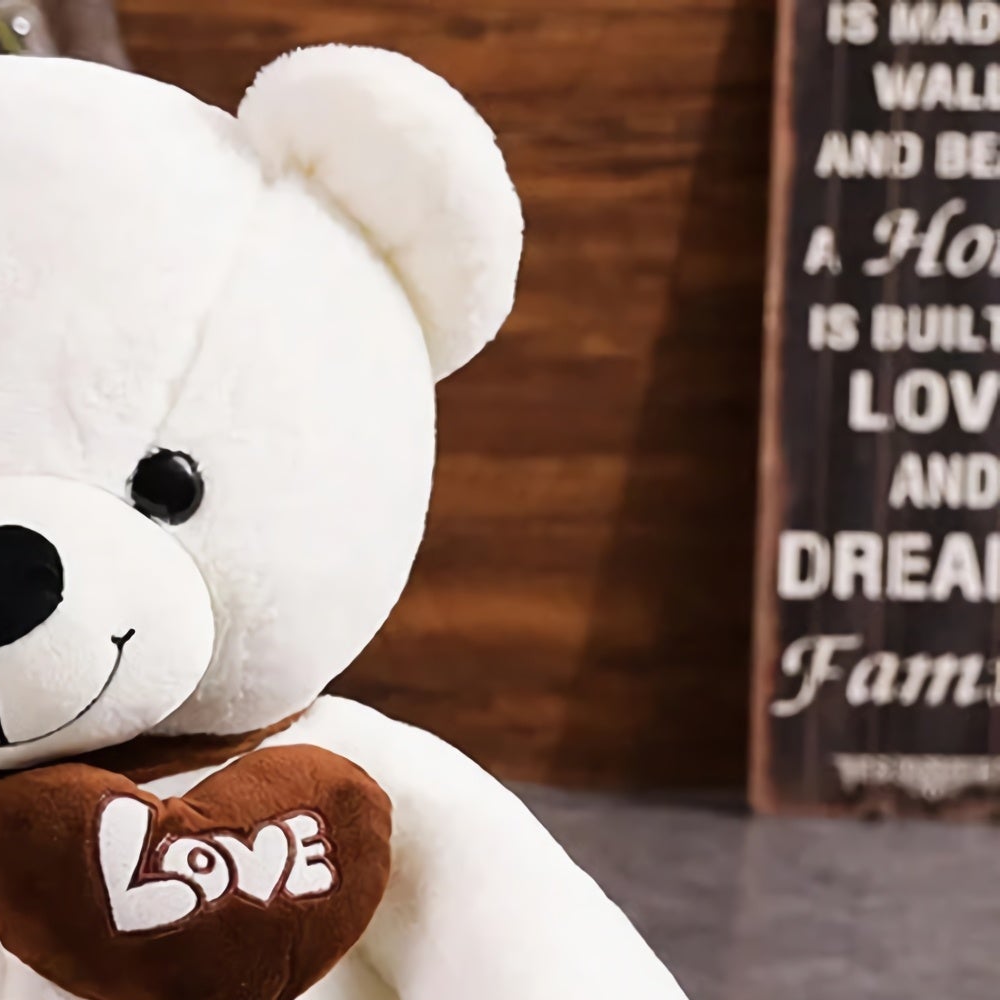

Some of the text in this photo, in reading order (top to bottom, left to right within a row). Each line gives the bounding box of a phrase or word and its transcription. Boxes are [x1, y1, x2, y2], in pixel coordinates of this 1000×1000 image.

[826, 0, 878, 45] IS
[814, 129, 924, 180] AND
[803, 196, 1000, 279] A Ho
[807, 303, 860, 352] IS
[889, 451, 1000, 510] AND
[97, 795, 336, 933] LOVE
